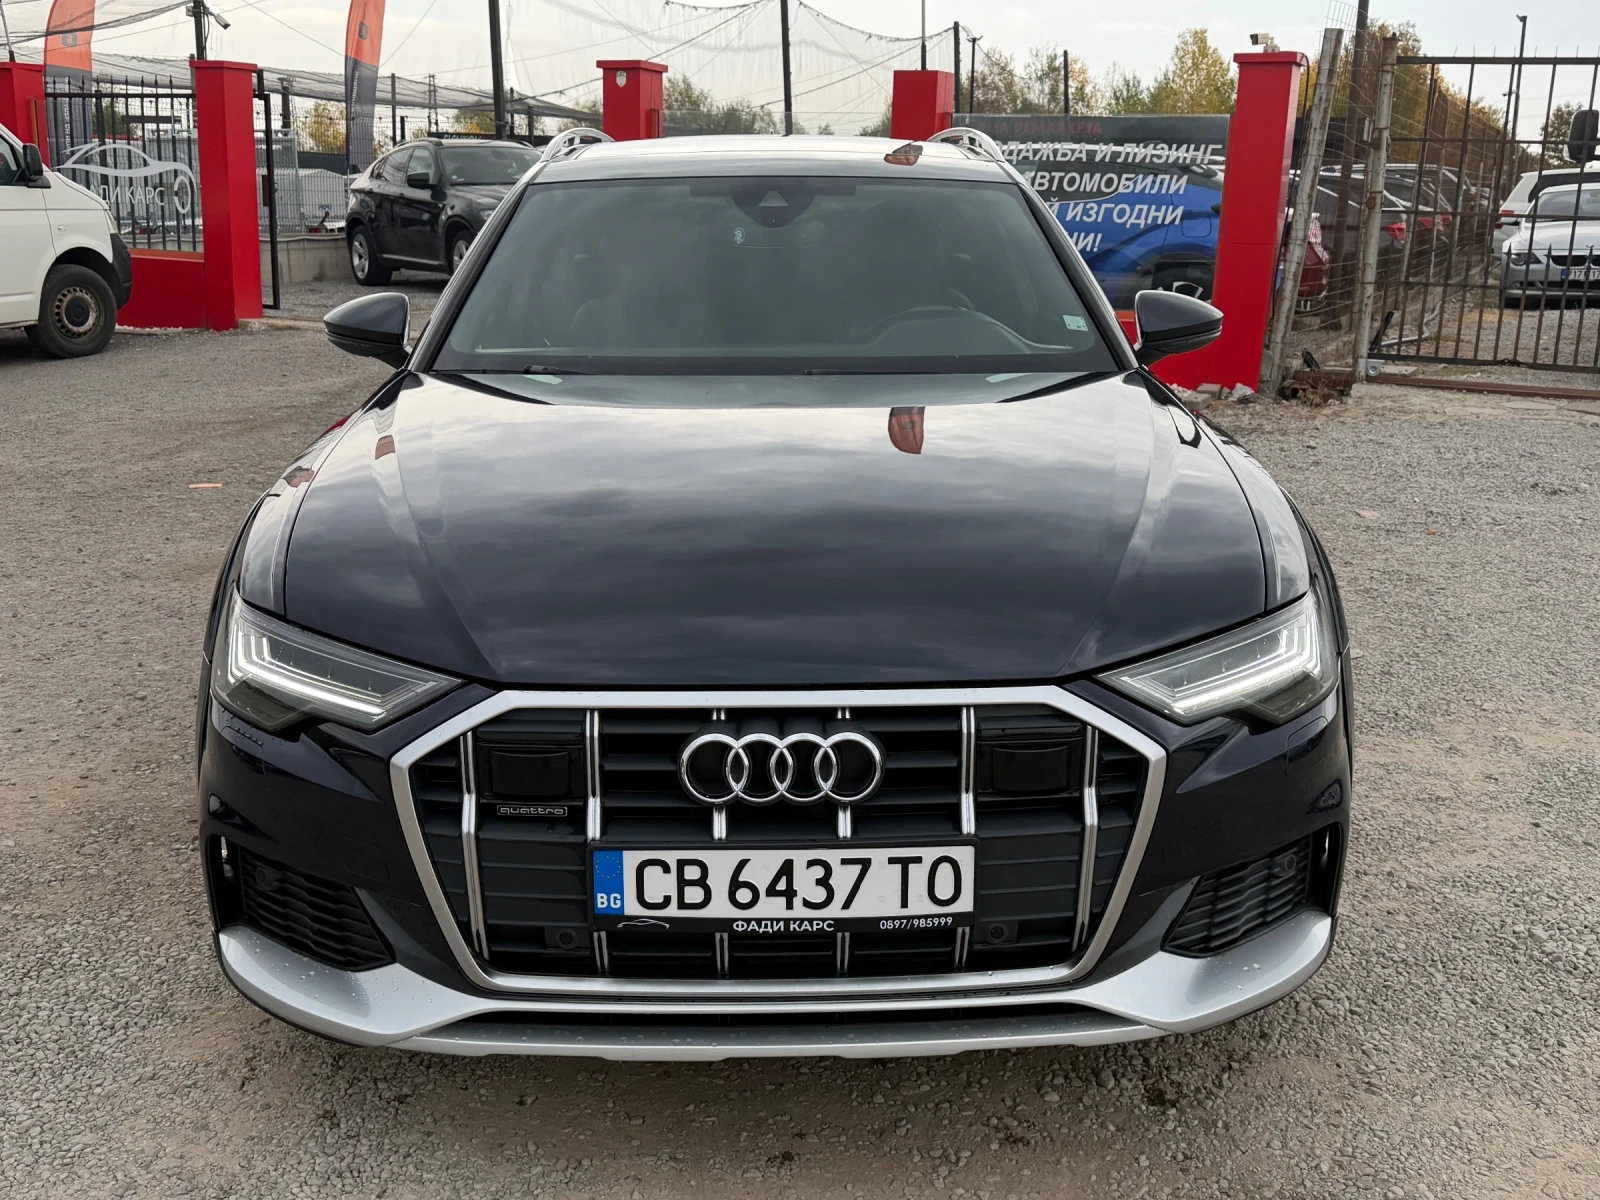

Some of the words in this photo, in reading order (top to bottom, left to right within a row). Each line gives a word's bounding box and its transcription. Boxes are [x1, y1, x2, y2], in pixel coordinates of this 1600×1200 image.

[1094, 142, 1115, 163] И
[1117, 143, 1223, 165] ЛИЗИНГ
[126, 186, 165, 206] КАРС
[1065, 202, 1185, 229] ИЗГОДНИ
[500, 806, 564, 815] quattro
[635, 858, 712, 910] CB
[727, 857, 872, 910] 6437
[888, 855, 963, 908] TO
[597, 893, 622, 909] BG
[733, 920, 785, 933] ФАДИ
[789, 920, 835, 932] КАРС
[879, 917, 953, 930] 0897/985999
